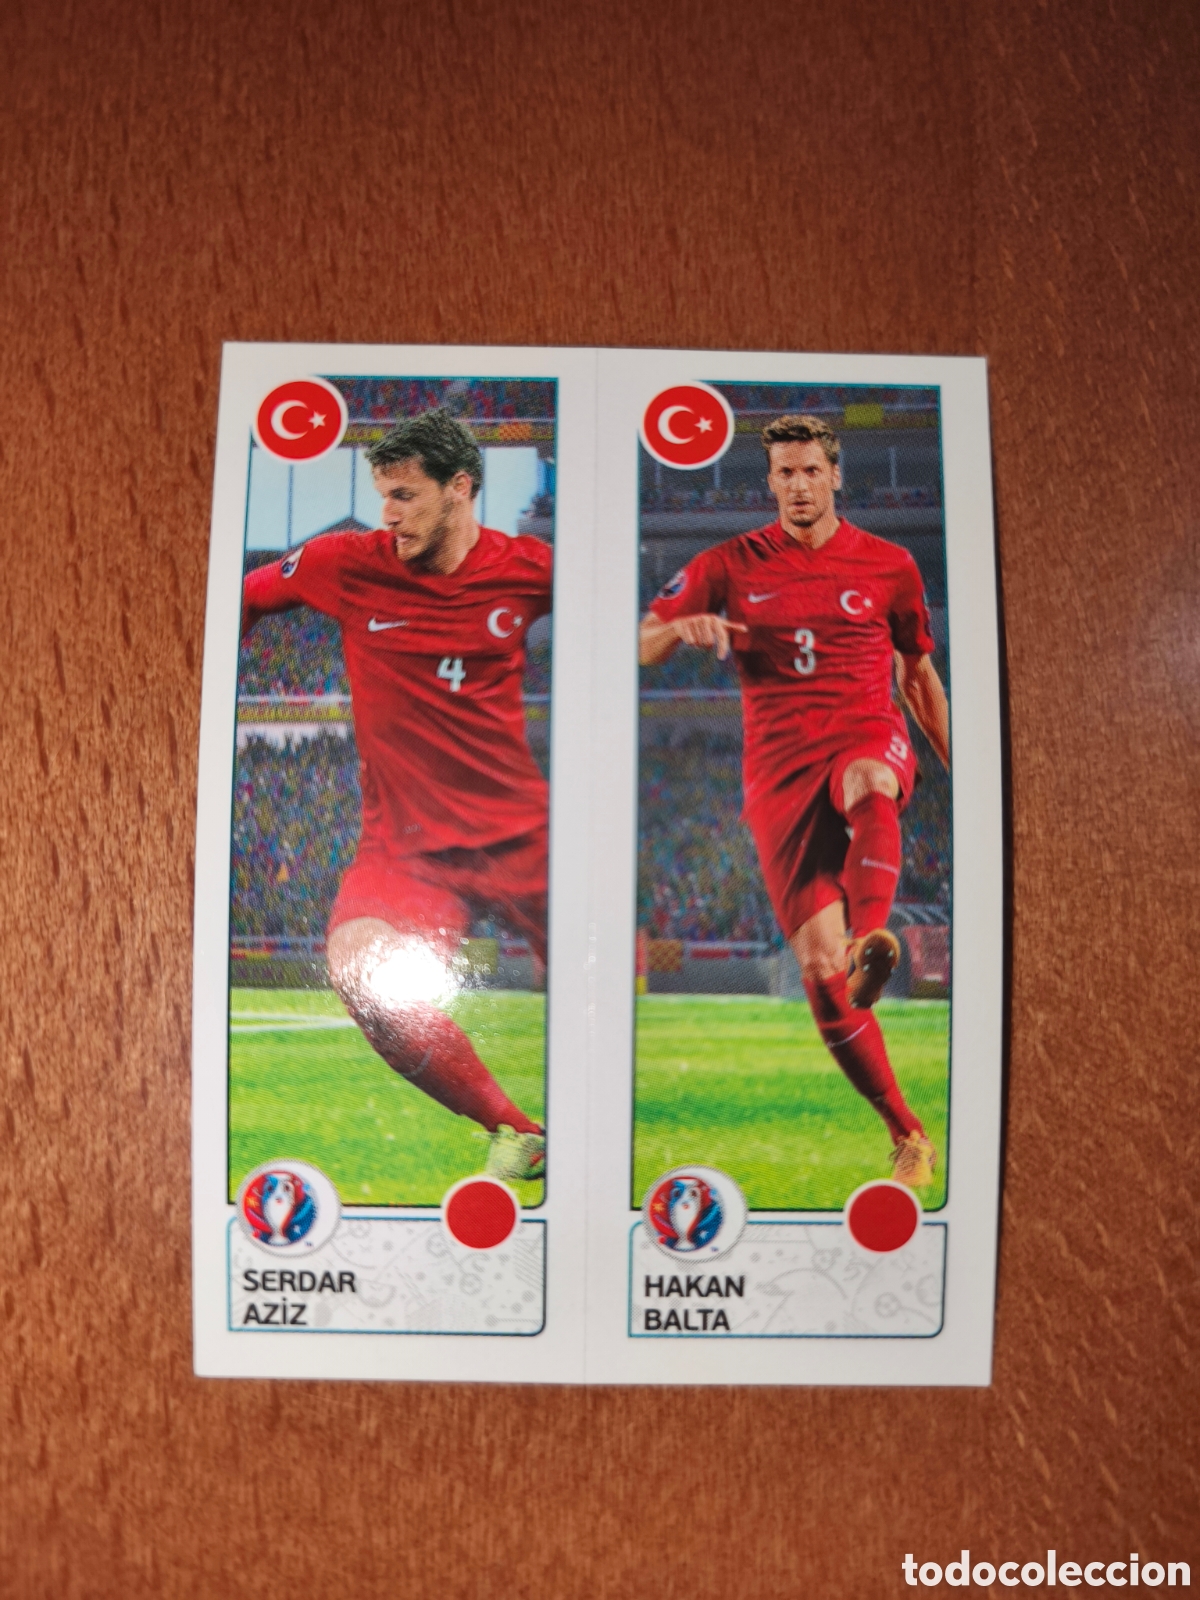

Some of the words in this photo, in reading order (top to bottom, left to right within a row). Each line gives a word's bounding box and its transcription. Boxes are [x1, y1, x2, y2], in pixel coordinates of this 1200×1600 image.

[794, 628, 815, 675] 3
[436, 656, 466, 693] 4
[243, 1270, 356, 1293] SERDAR
[644, 1274, 745, 1297] HAKAN
[243, 1297, 307, 1325] AZİZ
[644, 1308, 730, 1331] BALTA
